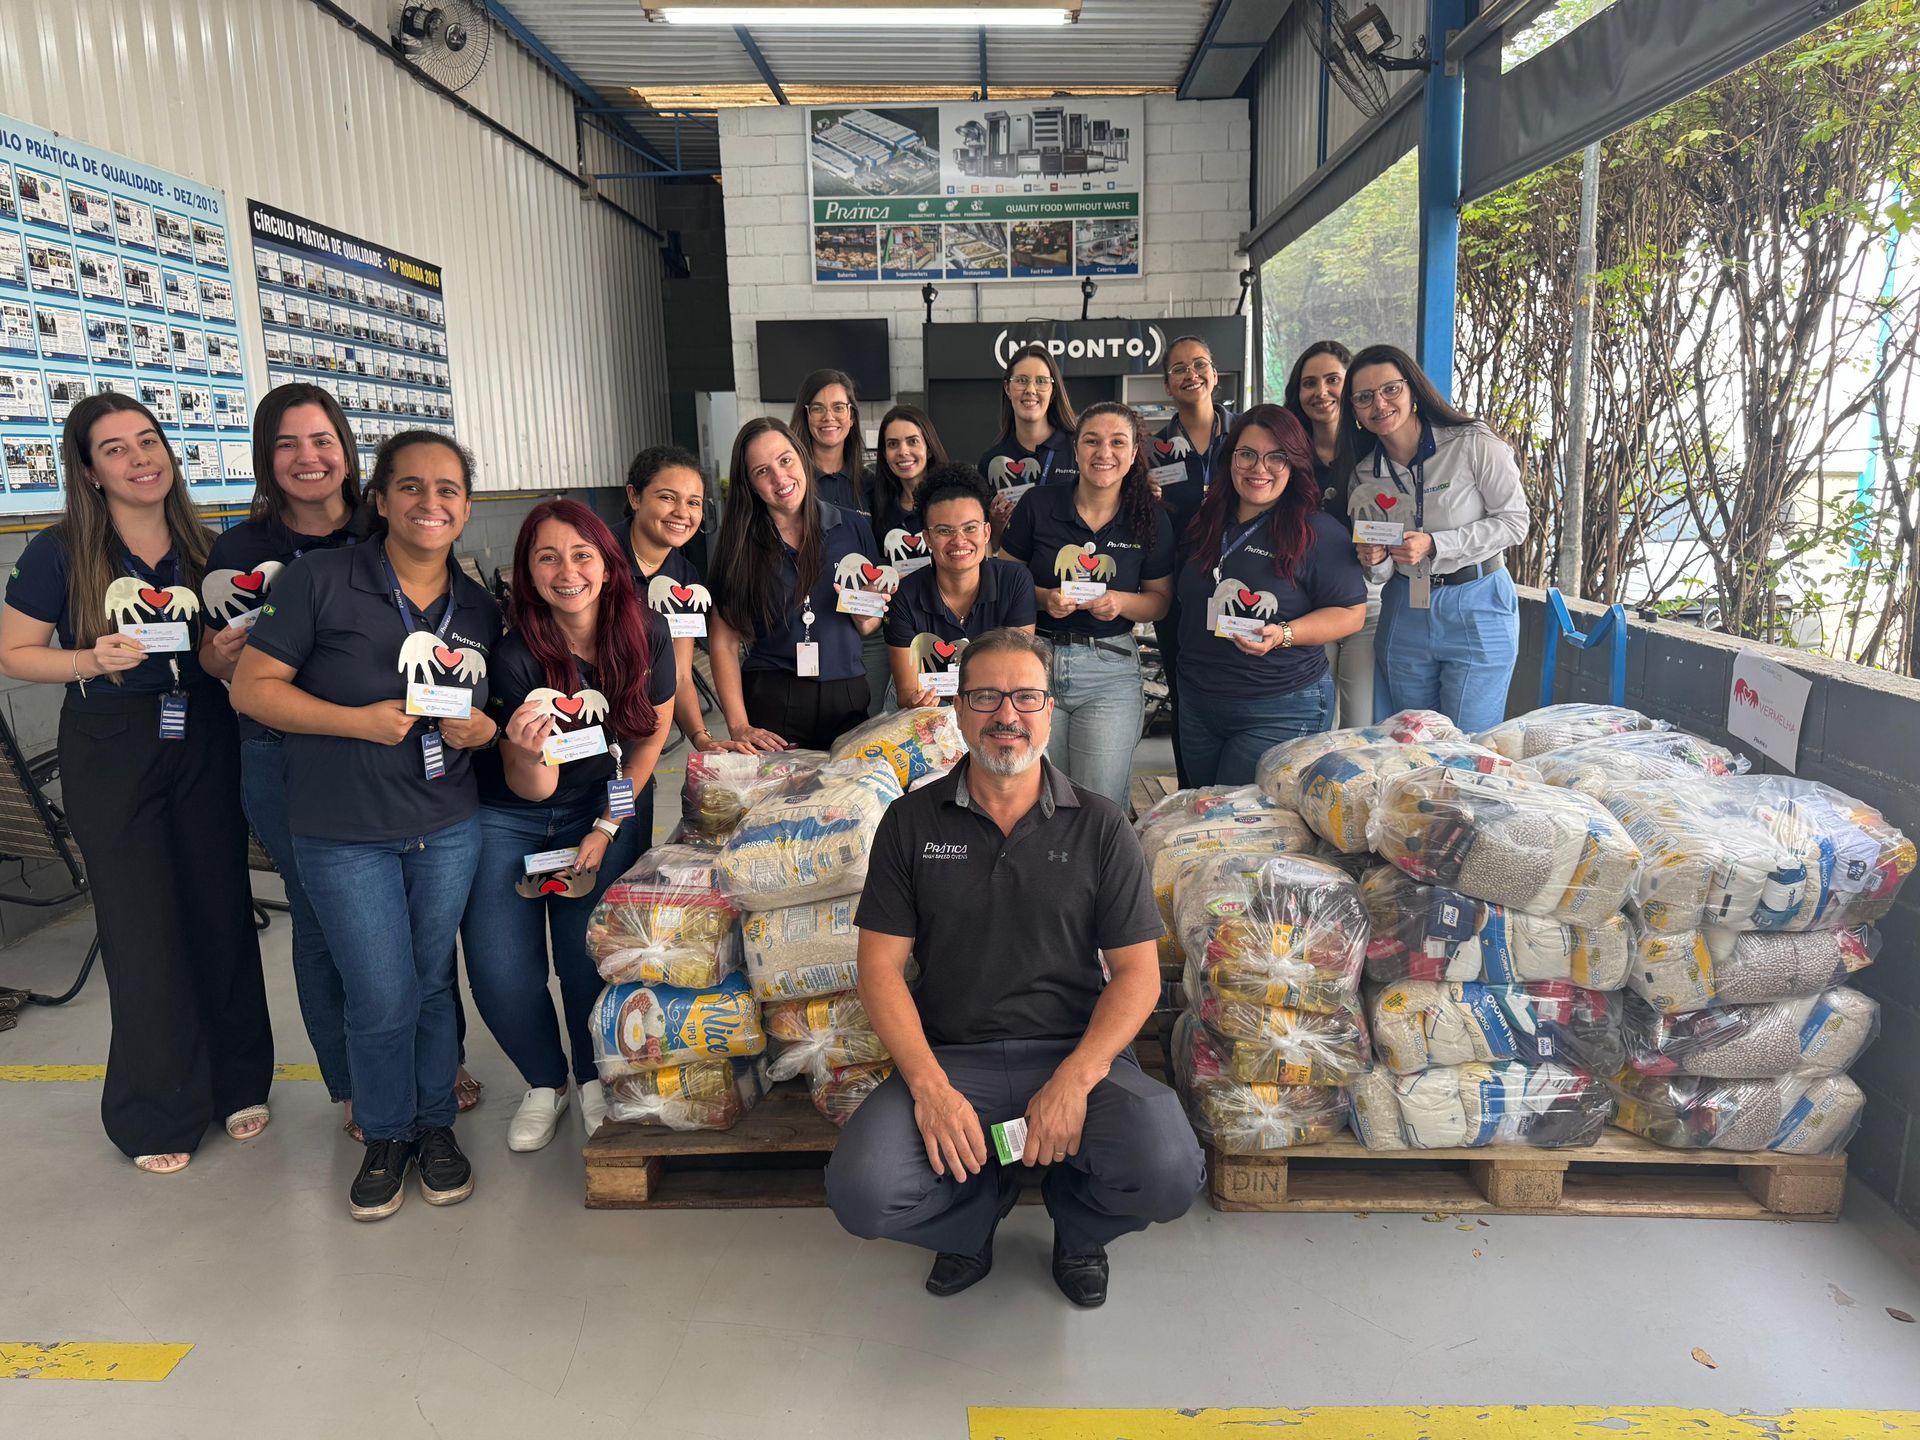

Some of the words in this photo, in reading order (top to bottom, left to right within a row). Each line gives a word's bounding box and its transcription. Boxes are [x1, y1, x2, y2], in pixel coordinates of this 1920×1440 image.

[0, 129, 21, 151] LO
[26, 138, 80, 170] PRÁTICA
[82, 157, 98, 176] DE
[101, 163, 164, 196] QUALIDADE
[174, 187, 218, 214] DEZ/2013
[826, 201, 890, 220] PRÁTICA
[1006, 203, 1038, 214] QUALITY
[1040, 203, 1063, 212] FOOD
[1065, 202, 1102, 211] WITHOUT
[1104, 201, 1130, 210] WASTE
[254, 208, 294, 240] CÍRCULO
[296, 225, 331, 253] PRÁTICA
[331, 236, 342, 255] DE
[343, 241, 382, 268] QUALIDADE
[400, 261, 425, 282] RODADA
[425, 270, 440, 288] 2019
[1096, 266, 1117, 274] Catering
[1759, 702, 1796, 732] VERMELHA
[924, 842, 968, 853] PRÁTICA
[1487, 995, 1508, 1030] MIMOSO
[687, 1022, 696, 1040] TIPO
[1232, 1170, 1279, 1192] DIN
